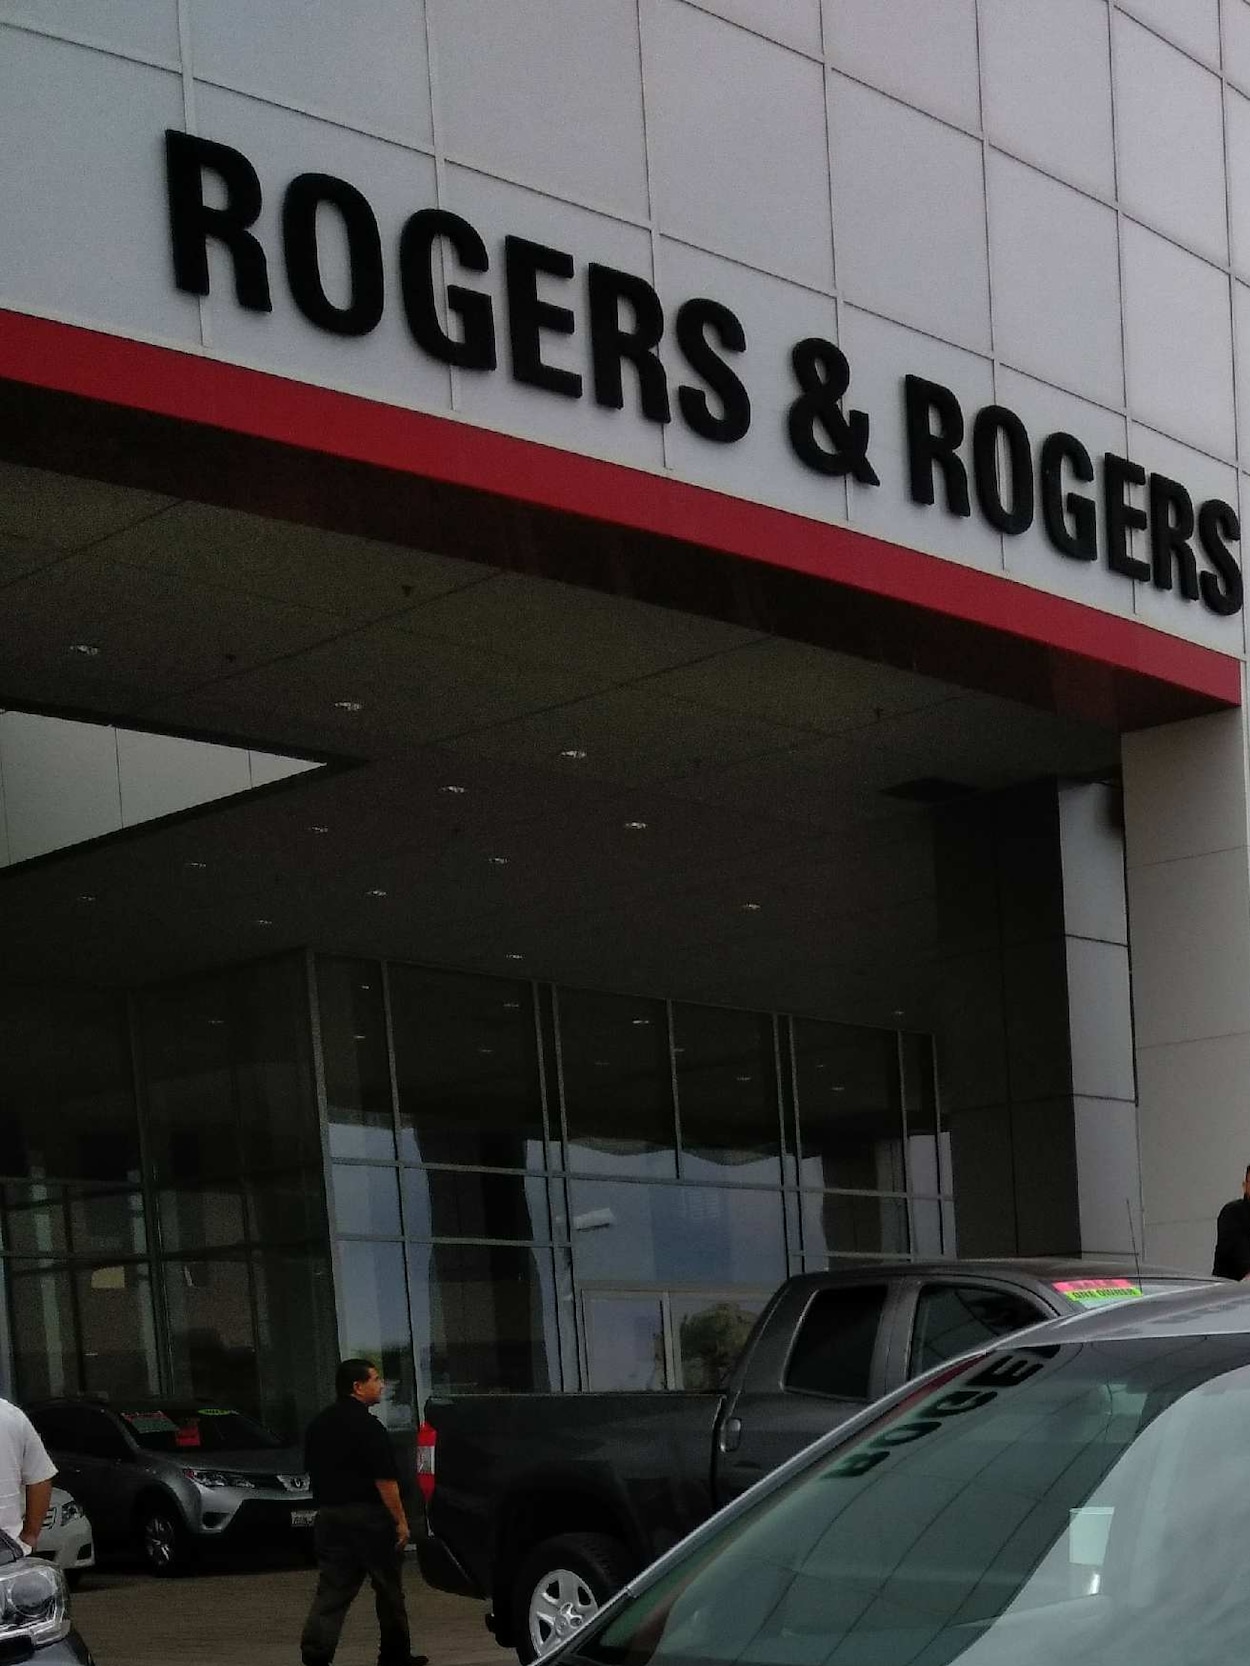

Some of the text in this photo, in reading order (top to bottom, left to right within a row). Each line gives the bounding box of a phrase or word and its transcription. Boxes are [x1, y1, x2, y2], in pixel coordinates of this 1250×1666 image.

[165, 129, 1244, 616] ROGERS & ROGERS
